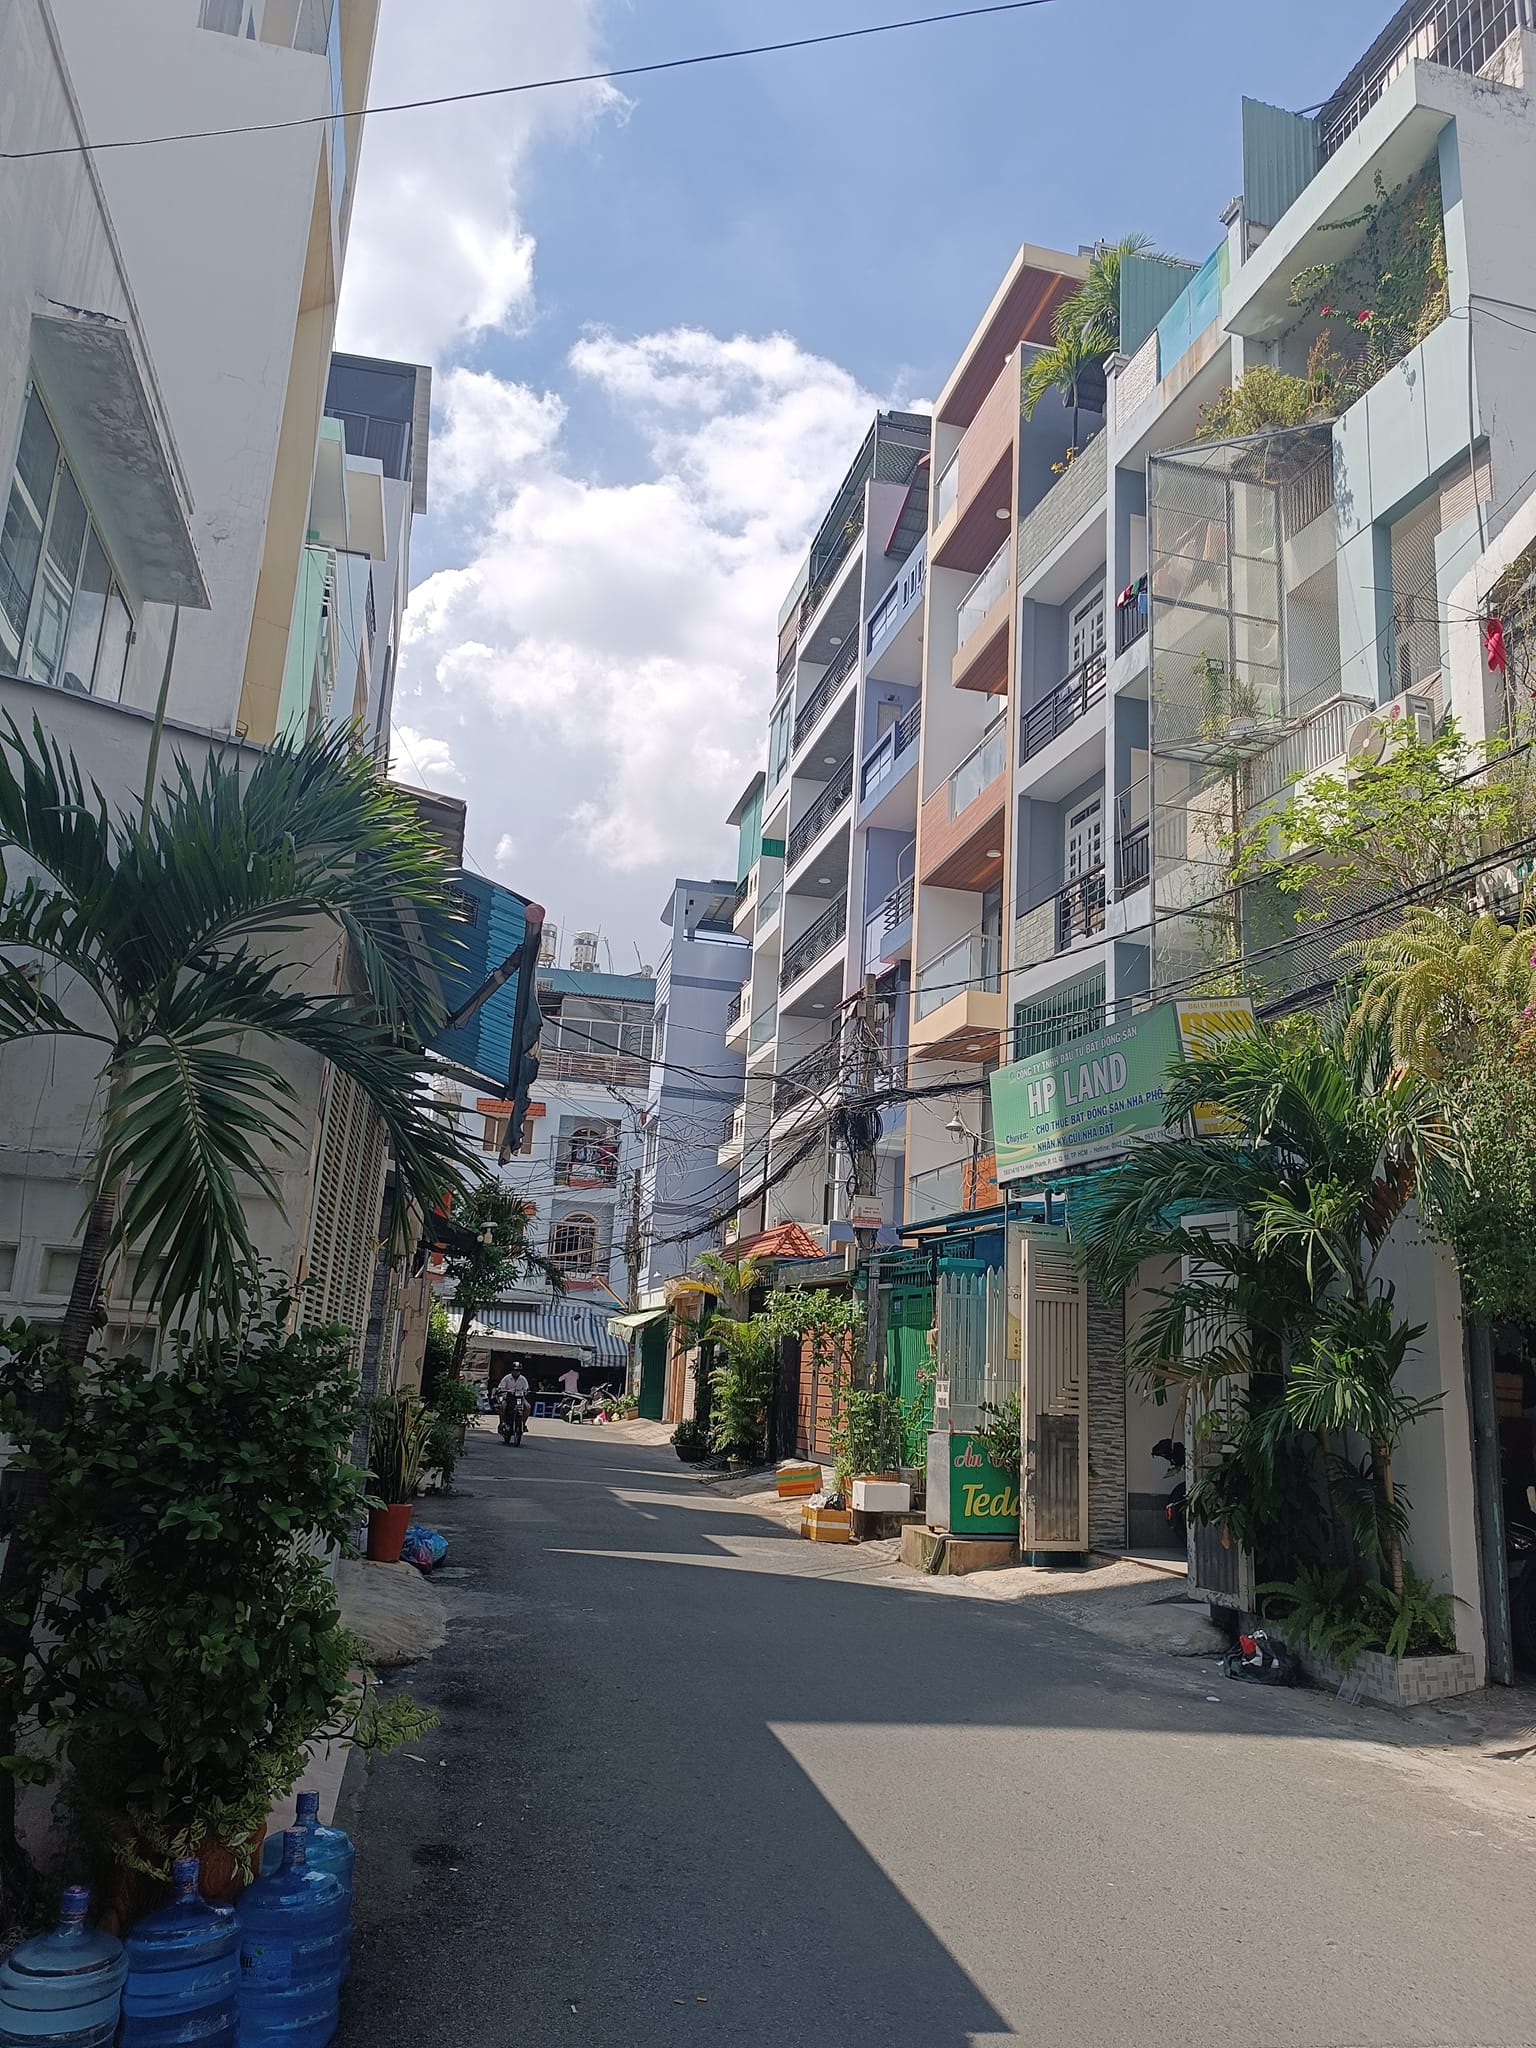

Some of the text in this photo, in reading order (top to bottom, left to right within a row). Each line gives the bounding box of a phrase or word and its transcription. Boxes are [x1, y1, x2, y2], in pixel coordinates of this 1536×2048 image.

[1032, 1063, 1040, 1073] TY
[1042, 1057, 1059, 1070] TNHH
[1027, 1052, 1127, 1118] HP LAND
[1035, 1122, 1049, 1135] CHO
[1051, 1115, 1069, 1131] THUÊ
